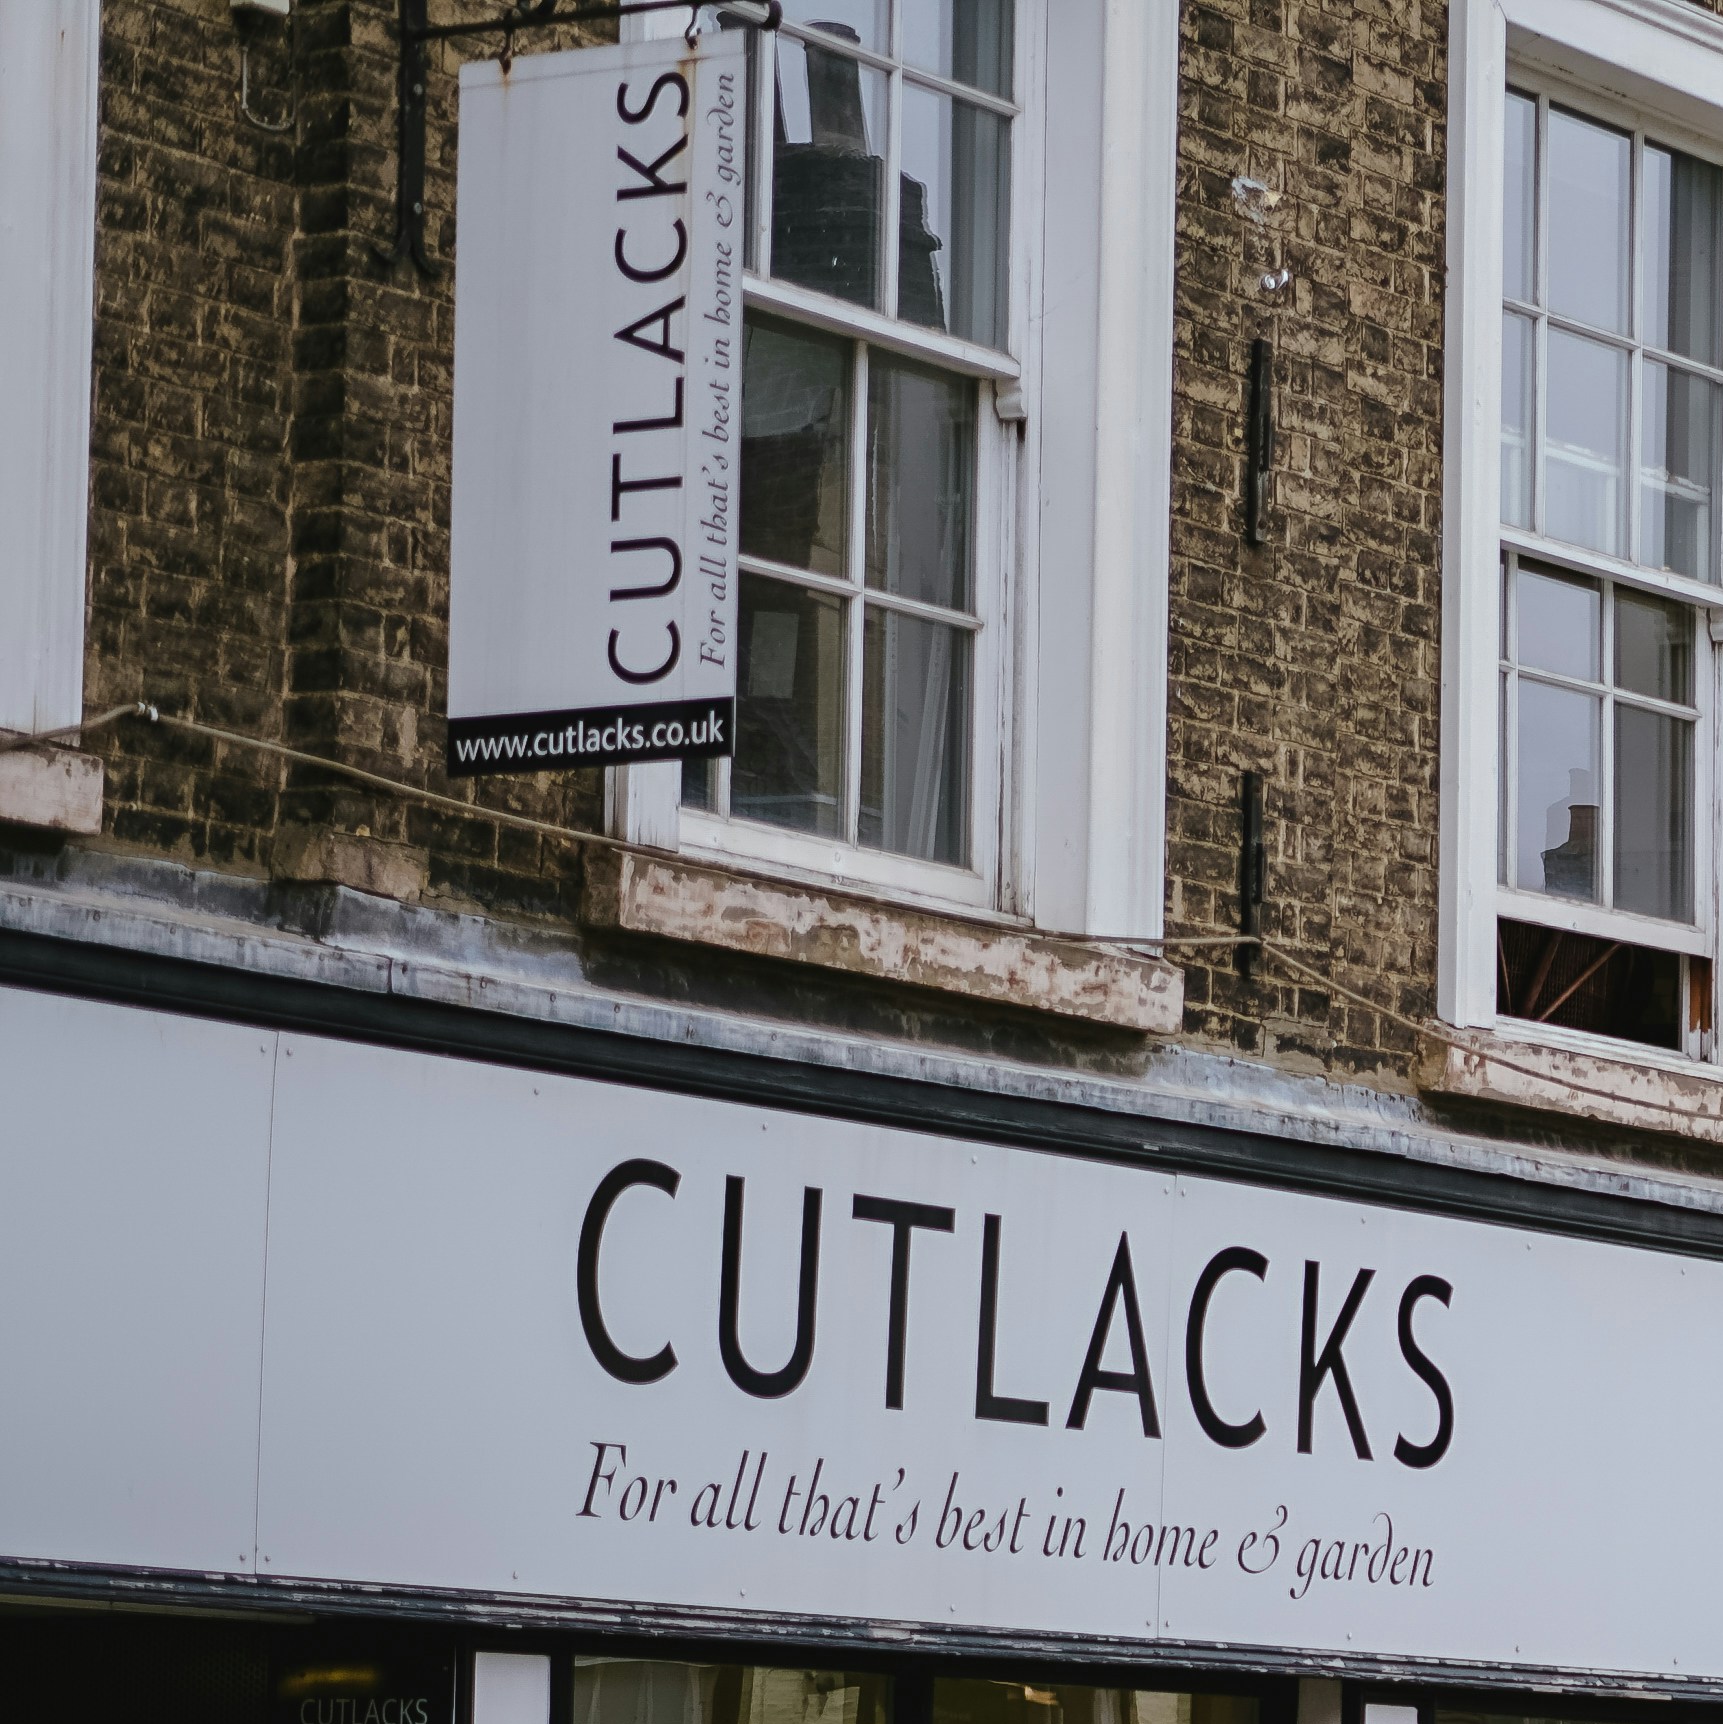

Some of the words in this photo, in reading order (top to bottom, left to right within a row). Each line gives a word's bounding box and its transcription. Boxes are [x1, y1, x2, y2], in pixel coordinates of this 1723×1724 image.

[707, 73, 741, 186] garden
[706, 191, 733, 228] &
[704, 242, 732, 326] home
[607, 71, 690, 685] CUTLACKS
[704, 338, 731, 369] in
[701, 383, 729, 444] best
[699, 553, 728, 602] all
[700, 610, 726, 669] For
[456, 711, 724, 762] www.cutlacks.co.uk
[576, 1157, 1455, 1470] CUTLACKS
[575, 1441, 678, 1522] For
[690, 1450, 768, 1531] all
[935, 1471, 1031, 1554] best
[1042, 1487, 1086, 1559] in
[1103, 1487, 1219, 1569] home
[1237, 1505, 1288, 1574] &
[1290, 1512, 1434, 1600] garden
